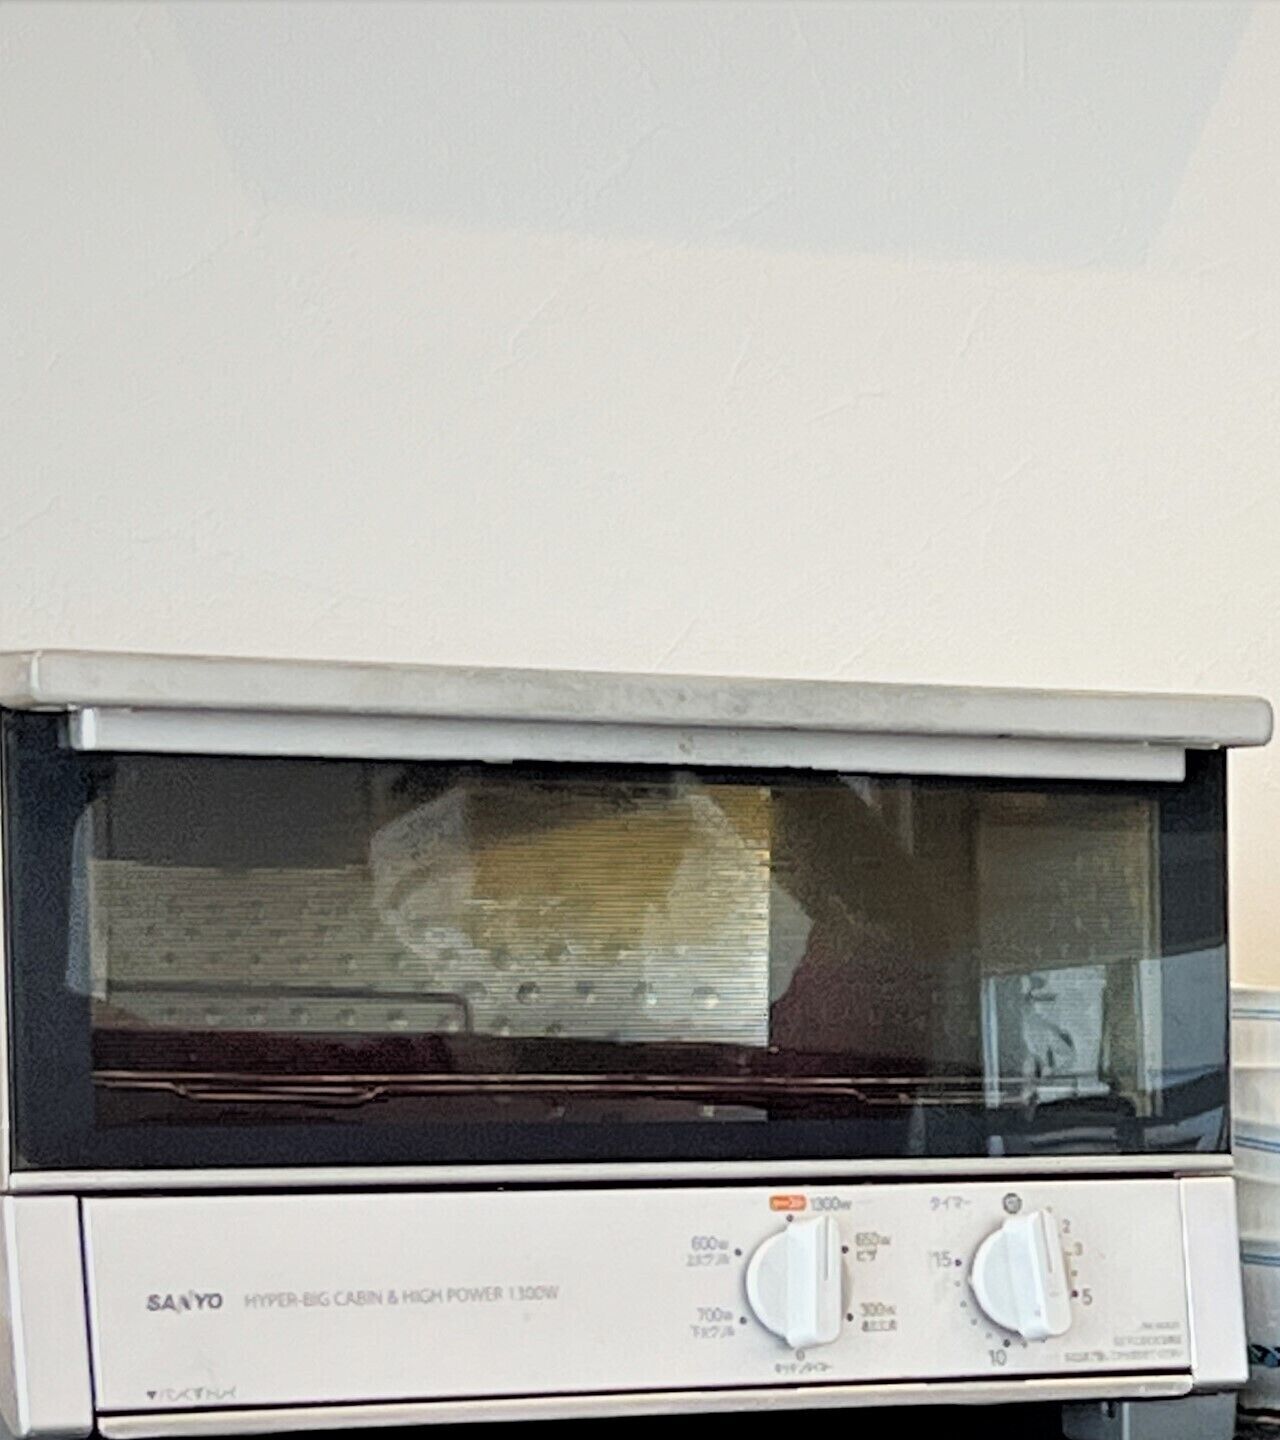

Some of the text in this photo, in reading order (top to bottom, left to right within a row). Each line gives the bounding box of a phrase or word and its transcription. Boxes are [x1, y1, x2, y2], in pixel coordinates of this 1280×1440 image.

[932, 1250, 952, 1268] 15
[146, 1291, 224, 1313] SANYO
[244, 1291, 330, 1308] HYPER-BIG
[334, 1288, 383, 1306] CABIN
[402, 1288, 442, 1304] HIGH
[447, 1286, 503, 1303] POWER
[1082, 1287, 1093, 1306] 5
[988, 1349, 1008, 1367] 10
